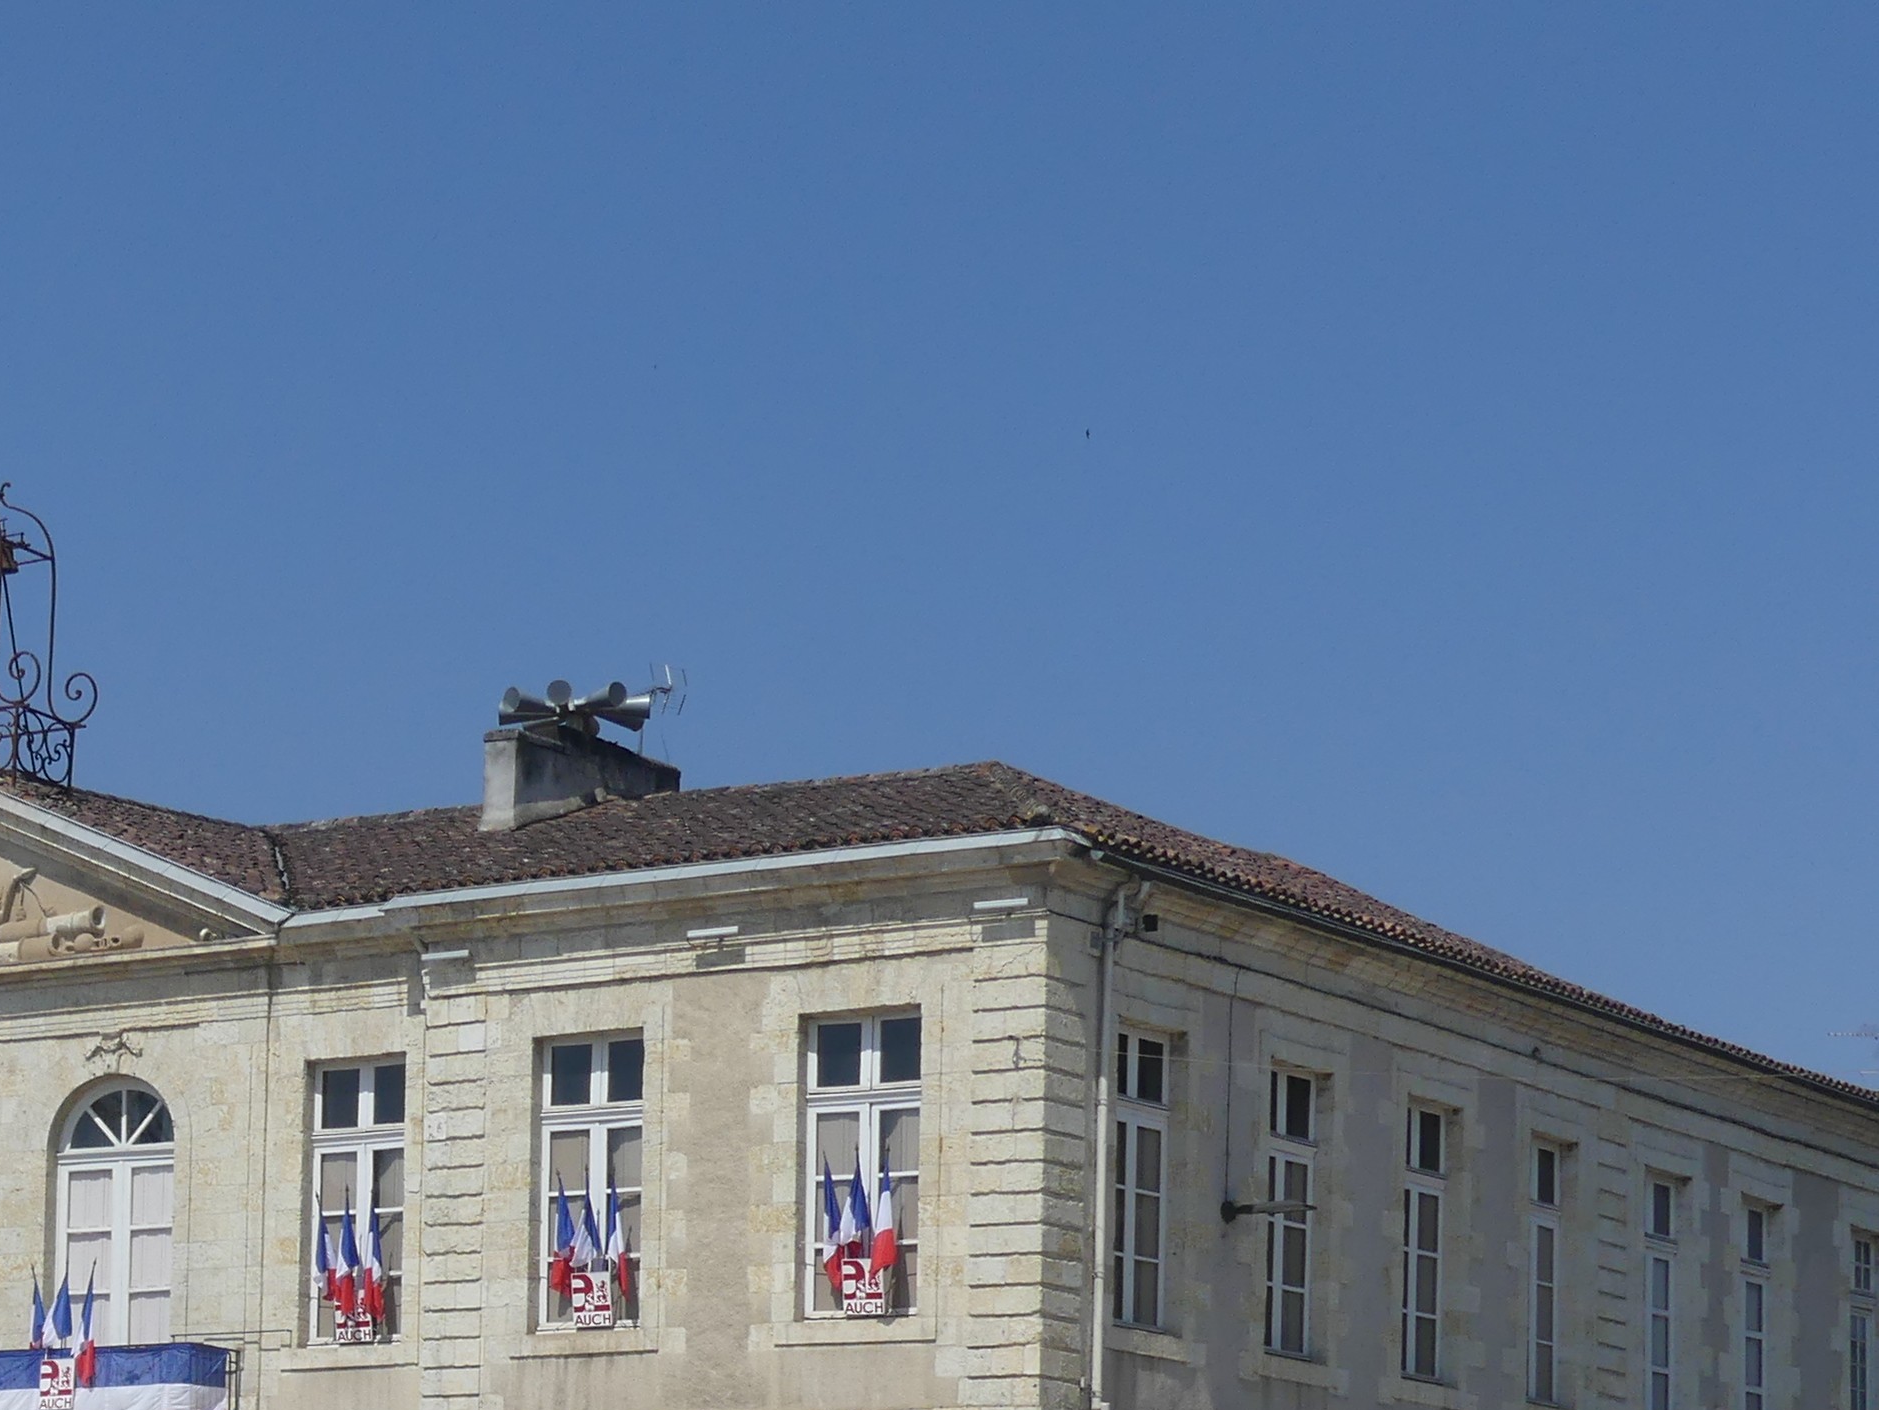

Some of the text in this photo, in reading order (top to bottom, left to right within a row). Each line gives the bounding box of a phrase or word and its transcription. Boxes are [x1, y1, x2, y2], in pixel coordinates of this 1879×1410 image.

[845, 1301, 884, 1314] AUCH
[575, 1313, 611, 1326] AUCH
[337, 1328, 372, 1341] AUCH
[40, 1397, 72, 1409] AUCH
